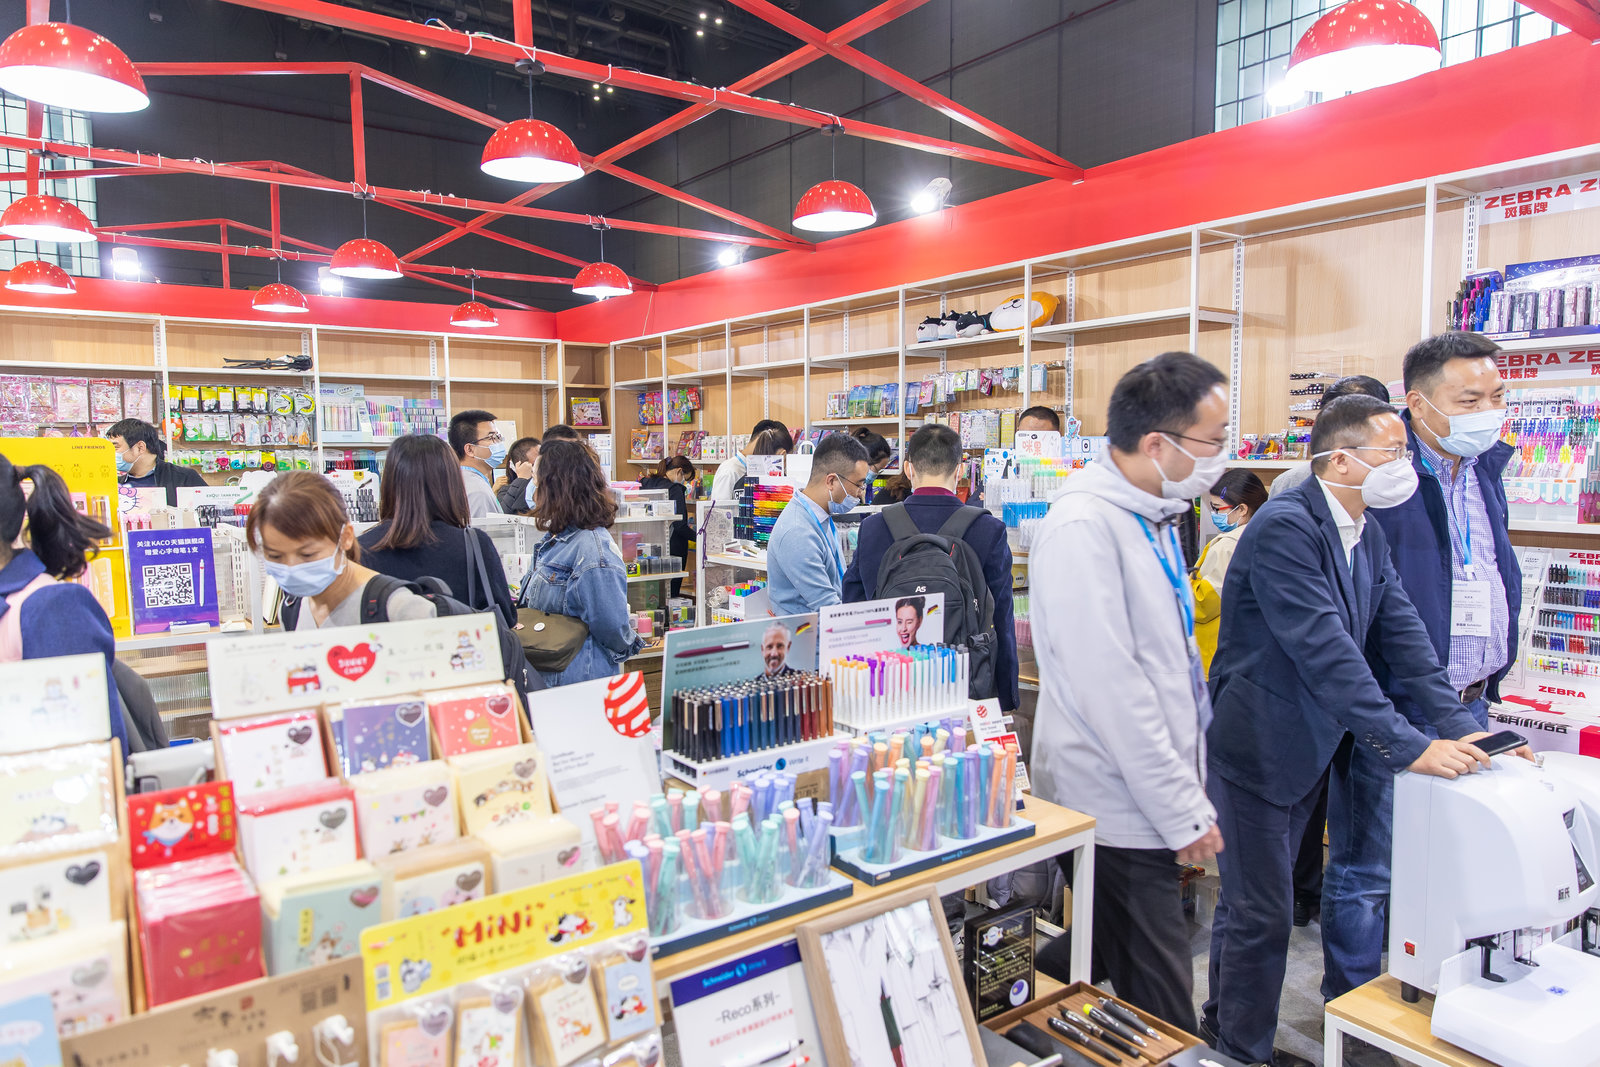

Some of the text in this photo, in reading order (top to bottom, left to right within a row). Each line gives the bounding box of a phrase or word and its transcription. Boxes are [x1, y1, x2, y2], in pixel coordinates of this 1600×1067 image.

[1484, 178, 1600, 210] ZEBRA Z
[1497, 352, 1562, 367] EBRA
[914, 585, 927, 593] AS
[1538, 685, 1587, 699] ZEBRA
